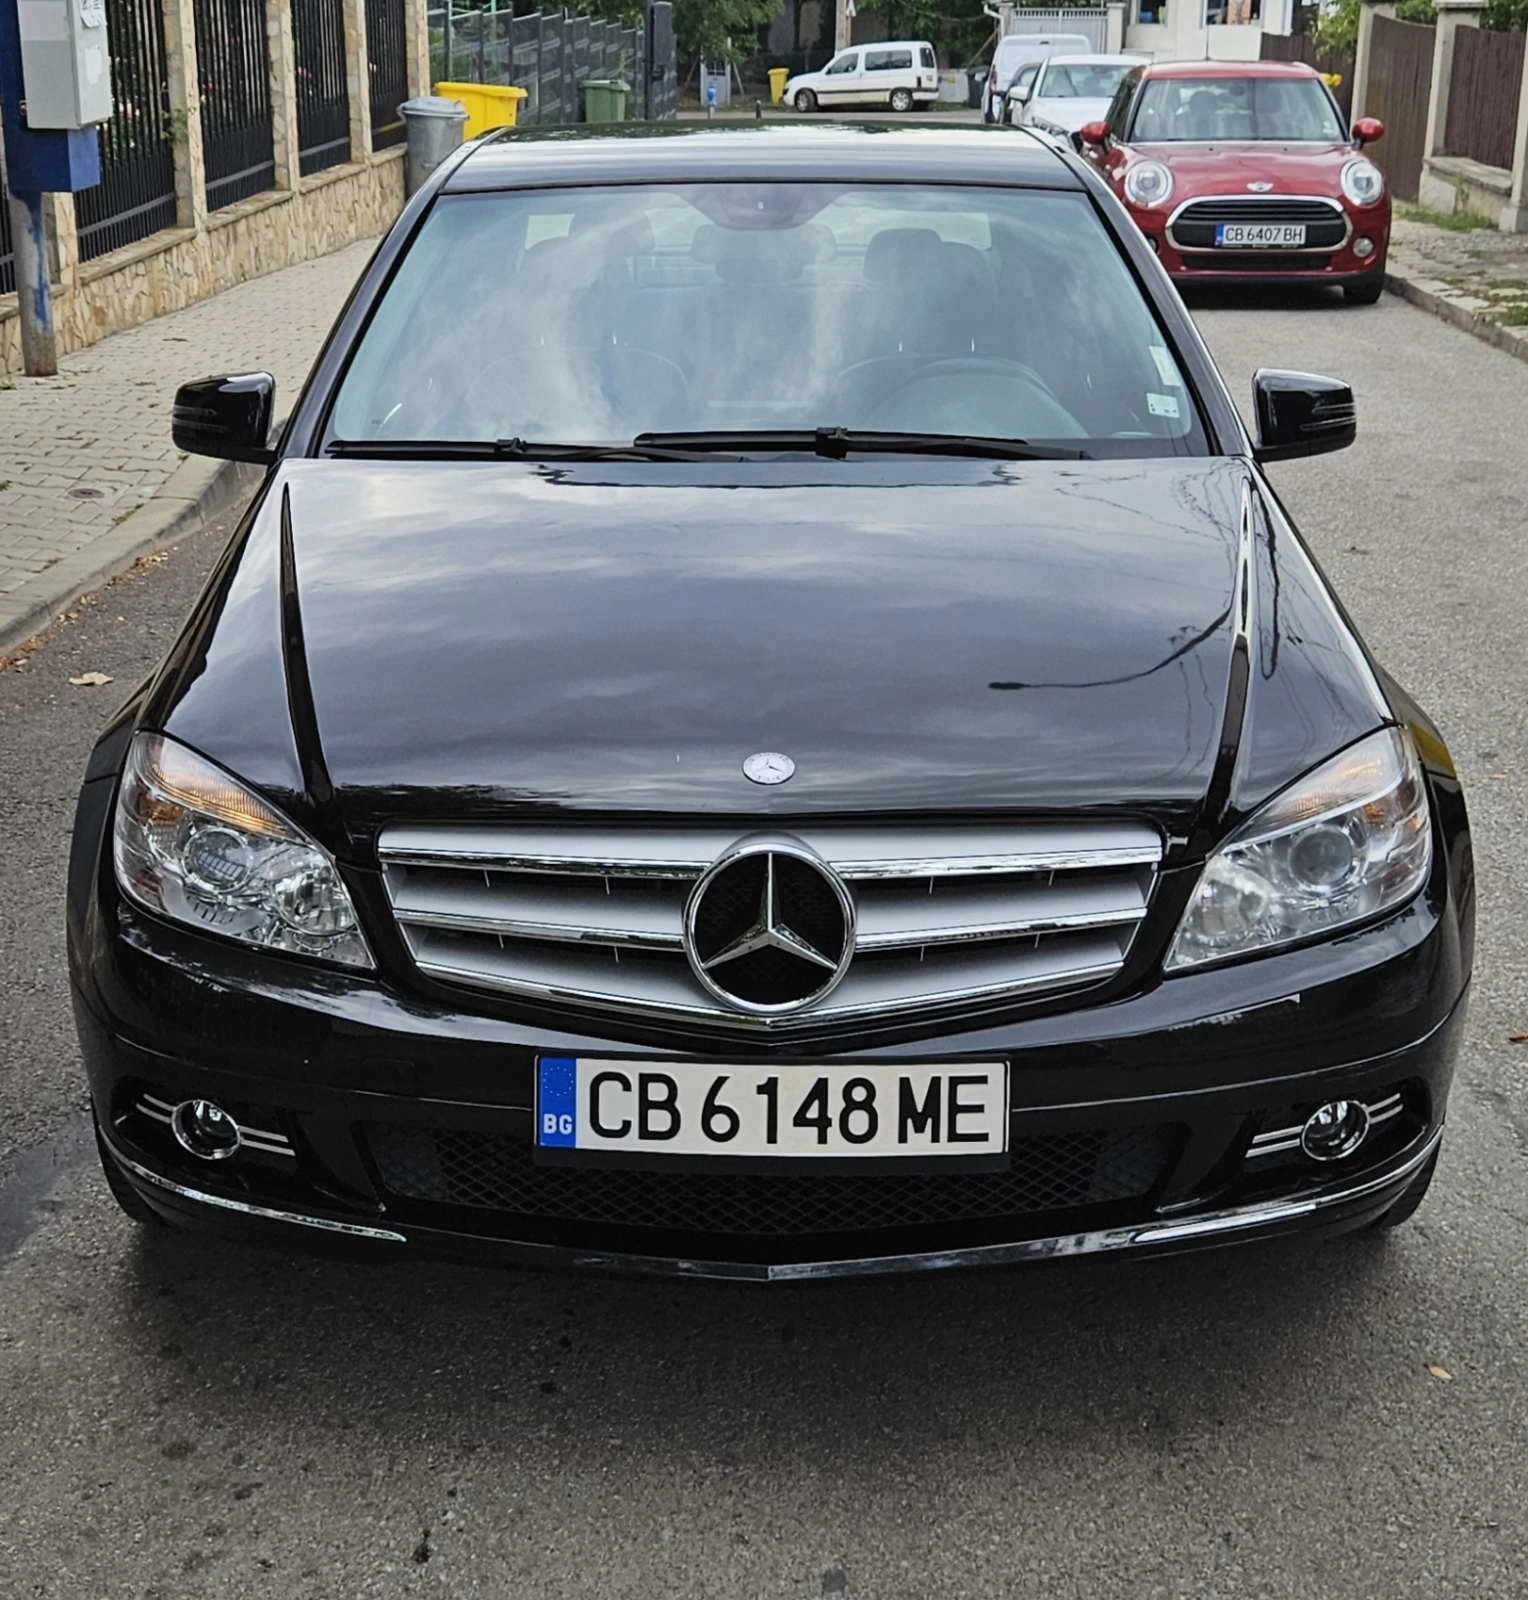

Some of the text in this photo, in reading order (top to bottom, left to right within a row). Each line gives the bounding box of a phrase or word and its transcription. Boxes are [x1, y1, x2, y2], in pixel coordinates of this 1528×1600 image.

[1225, 227, 1244, 241] CB
[1247, 227, 1280, 241] 6407
[1283, 227, 1303, 241] BH
[589, 1071, 990, 1145] CB 6148 ME
[543, 1113, 573, 1135] BG
